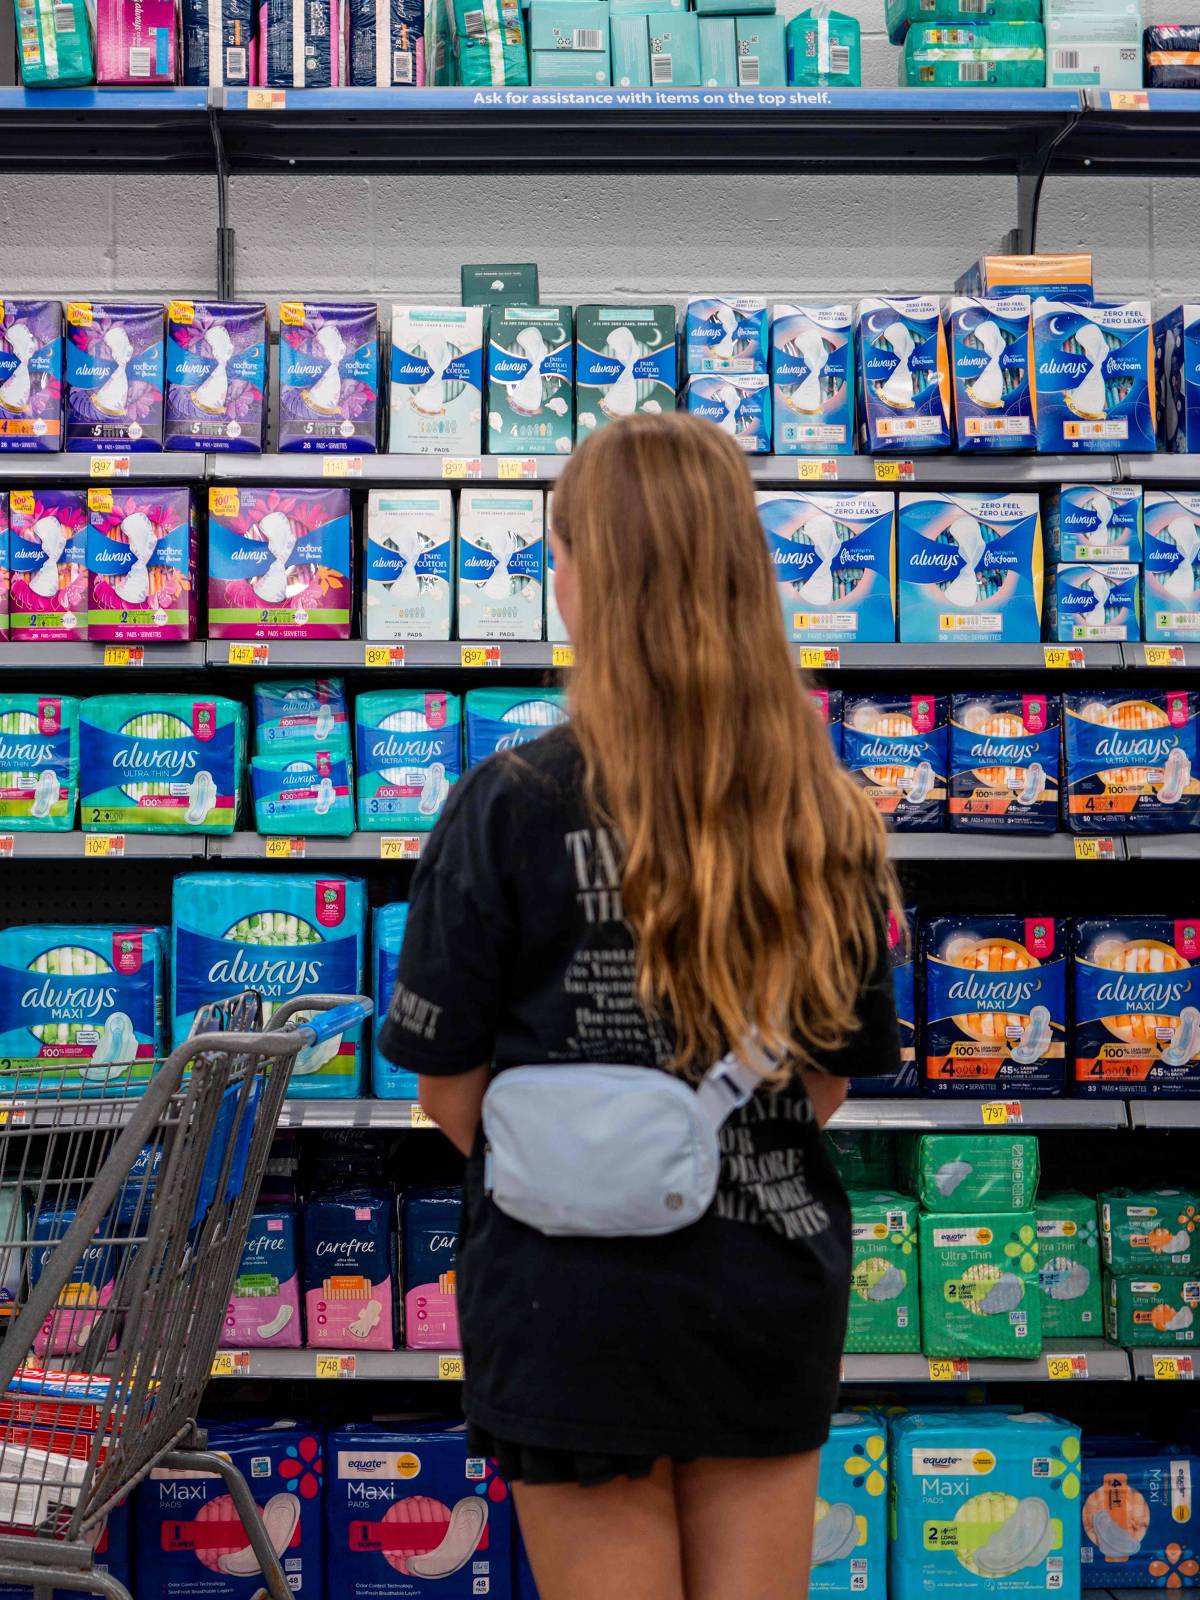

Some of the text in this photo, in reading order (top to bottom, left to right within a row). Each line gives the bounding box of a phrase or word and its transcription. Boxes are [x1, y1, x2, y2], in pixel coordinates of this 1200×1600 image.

[474, 92, 831, 107] Ask for assistance with items on the top shelf.
[288, 363, 322, 375] always
[590, 364, 620, 375] always
[777, 364, 807, 377] always
[1040, 361, 1087, 378] always
[231, 548, 268, 562] always
[465, 555, 497, 568] always
[517, 553, 533, 561] pure
[910, 552, 958, 570] always
[1150, 552, 1179, 564] always
[417, 559, 447, 568] cotton
[509, 558, 539, 567] cotton
[373, 735, 445, 763] always
[860, 739, 921, 763] always
[970, 739, 1032, 764] always
[1095, 732, 1170, 760] always
[112, 742, 200, 776] always
[208, 950, 321, 994] always
[21, 979, 117, 1017] always
[948, 974, 1034, 1009] always
[1097, 975, 1183, 1010] always
[977, 1001, 1005, 1009] MAXI
[1126, 1002, 1154, 1011] MAXI
[51, 1009, 83, 1018] MAXI
[941, 1251, 992, 1261] Ultra Thin
[348, 1460, 383, 1471] equate
[922, 1456, 958, 1468] equate
[159, 1483, 206, 1500] Maxi
[347, 1483, 394, 1500] Maxi
[922, 1479, 969, 1496] Maxi
[928, 1528, 937, 1540] 2
